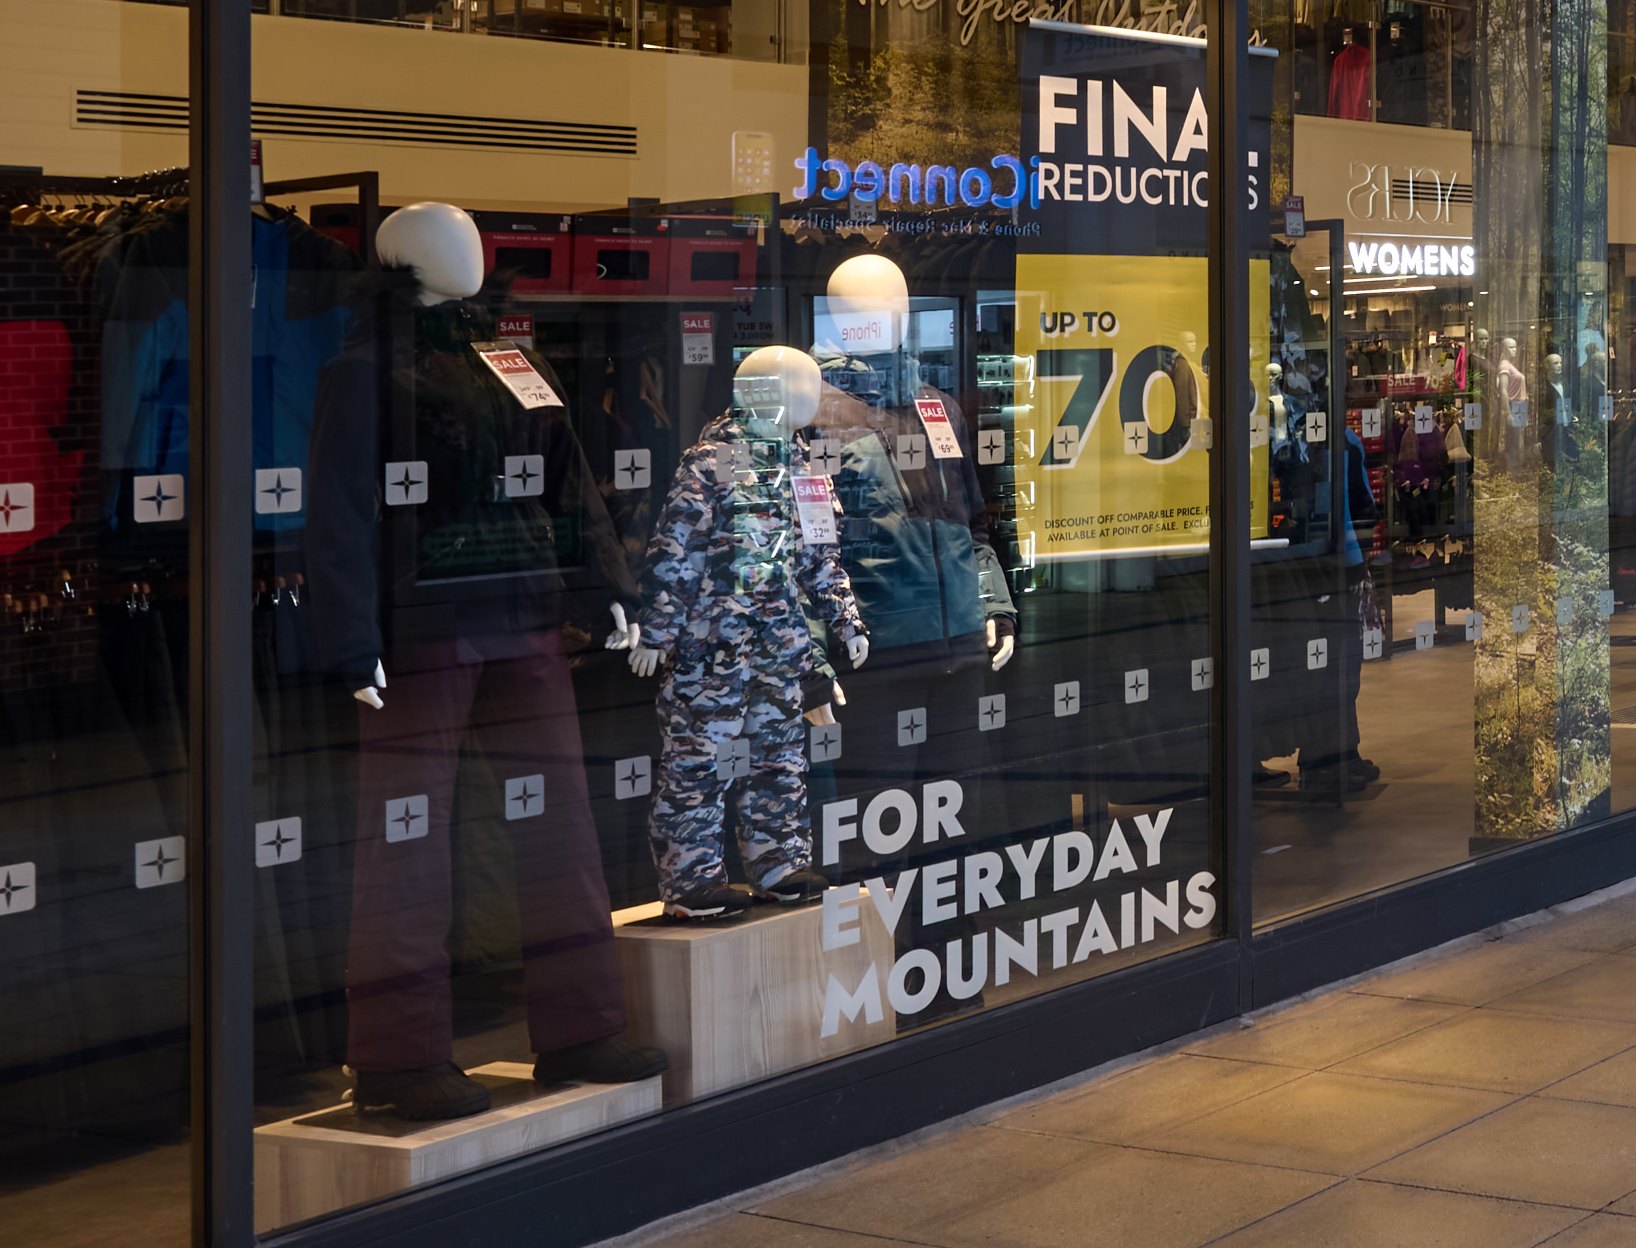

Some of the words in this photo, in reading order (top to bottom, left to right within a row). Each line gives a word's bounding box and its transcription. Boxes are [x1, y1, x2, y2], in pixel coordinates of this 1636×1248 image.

[1039, 74, 1258, 163] FINA
[1286, 201, 1303, 209] SALE
[1348, 241, 1476, 276] WOMENS
[499, 321, 531, 332] SALE
[683, 319, 711, 329] SALE
[1040, 312, 1077, 335] UP
[1083, 311, 1119, 336] TO
[494, 357, 527, 371] SALE
[1387, 376, 1416, 386] SALE
[921, 408, 945, 418] SALE
[798, 484, 826, 496] SALE
[1044, 516, 1095, 529] DISCOUNT
[1097, 515, 1114, 526] OFF
[1117, 509, 1175, 522] COMPARABLE
[1177, 506, 1203, 517] PRICE.
[1047, 529, 1096, 542] AVAILABLE
[1099, 528, 1110, 537] AT
[1112, 526, 1140, 537] POINT
[1142, 524, 1154, 534] OF
[1156, 521, 1179, 532] SALE.
[822, 779, 966, 867] FOR
[822, 808, 1174, 952] EVERYDAY
[820, 871, 1217, 1038] MOUNTAINS
